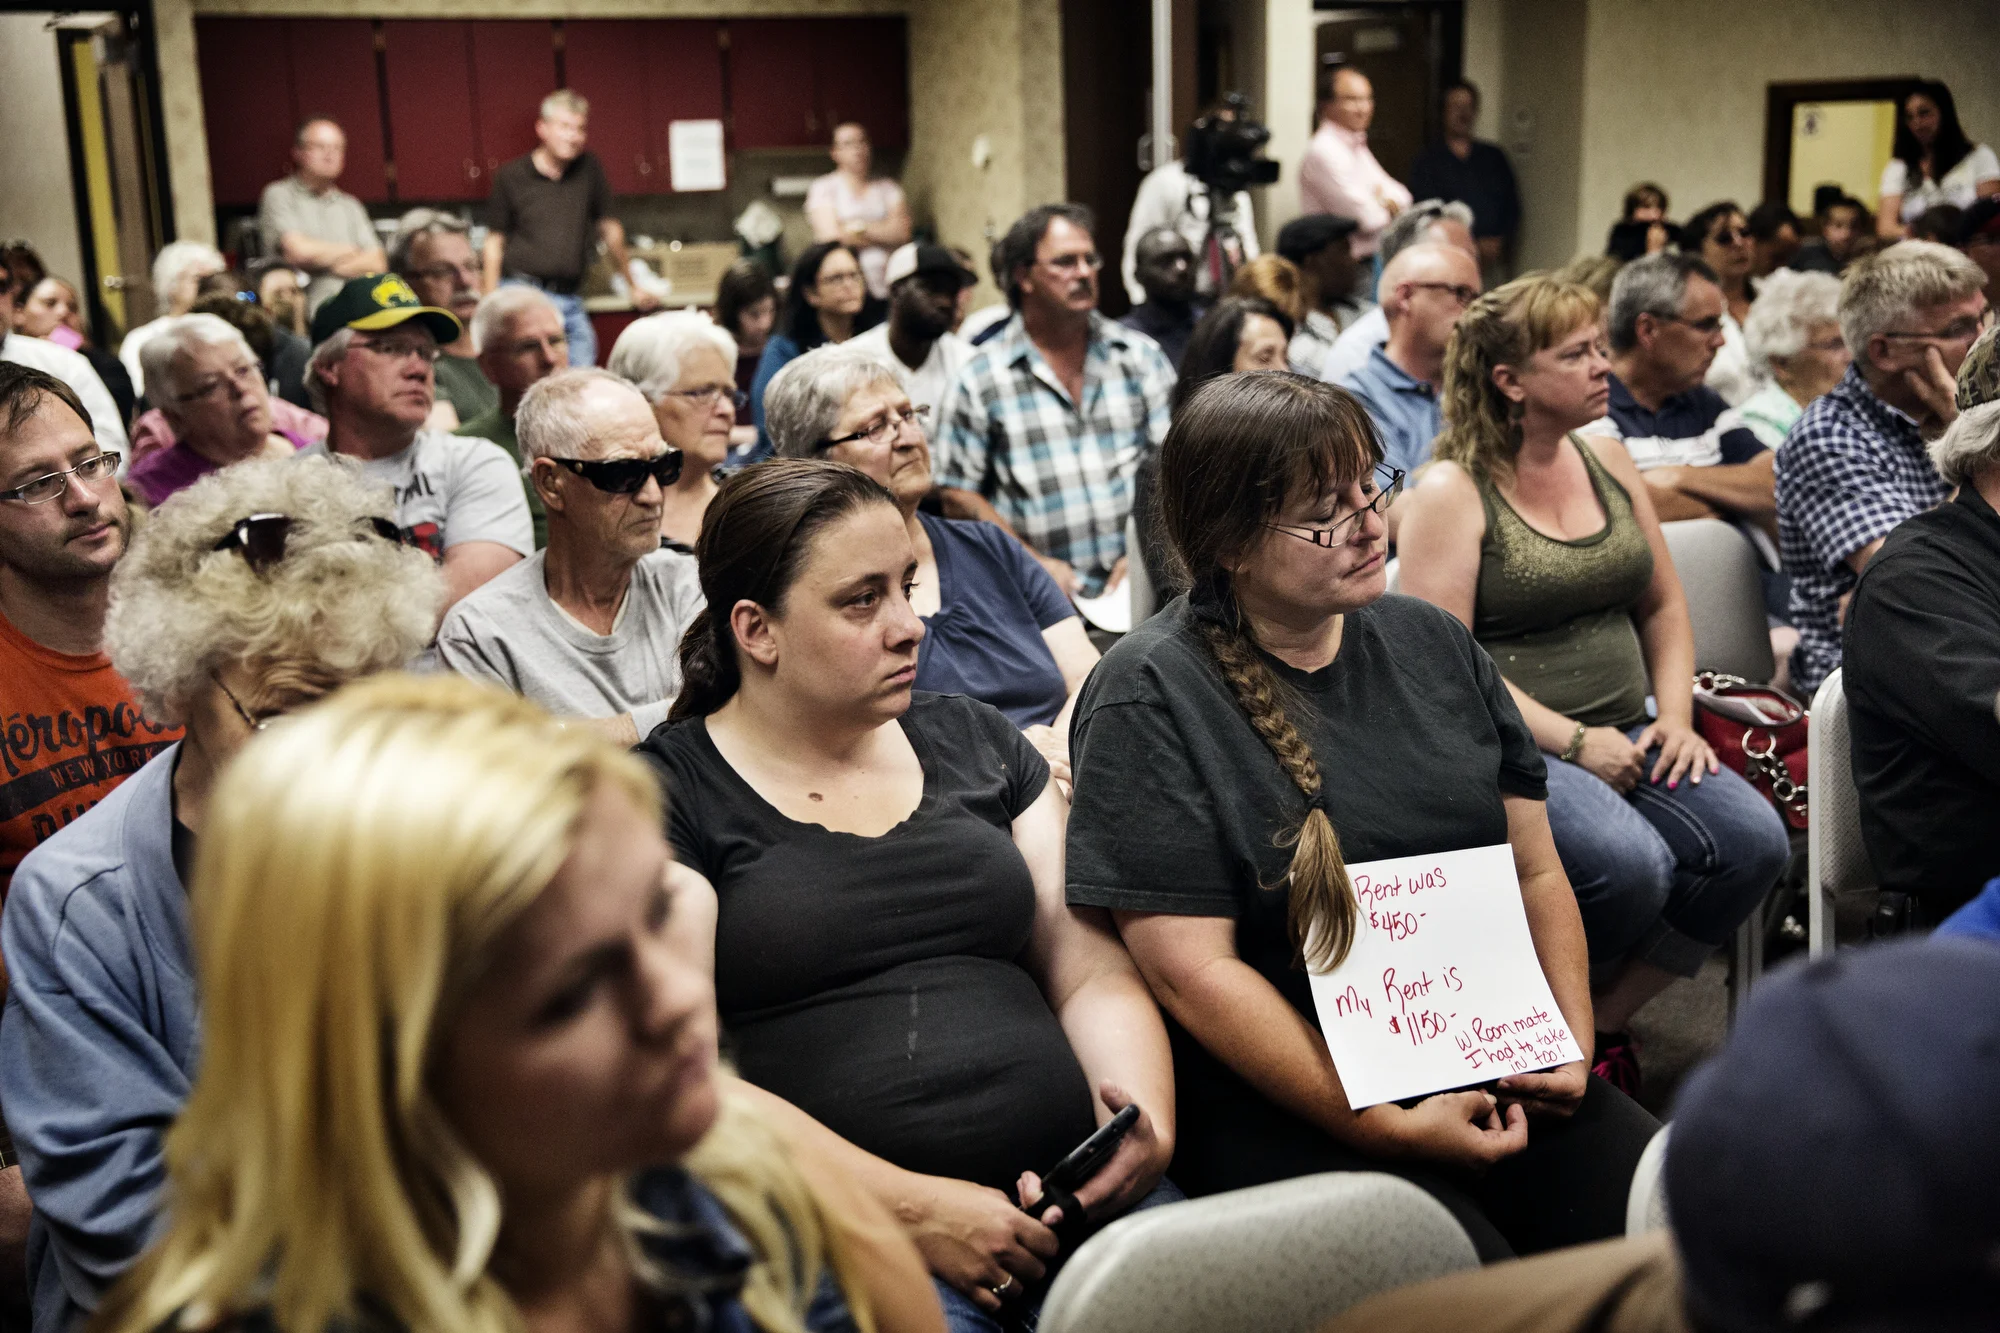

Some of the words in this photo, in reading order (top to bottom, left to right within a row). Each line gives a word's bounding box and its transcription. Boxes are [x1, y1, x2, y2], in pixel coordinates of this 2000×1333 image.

[50, 758, 96, 788] NEW
[1354, 875, 1402, 910] Rent
[1408, 867, 1447, 894] was
[1383, 967, 1434, 1015] Rent
[1464, 1048, 1483, 1069] I
[1482, 1040, 1516, 1063] had
[1515, 1038, 1534, 1053] to
[1535, 1027, 1568, 1046] take
[1534, 1043, 1565, 1065] too!
